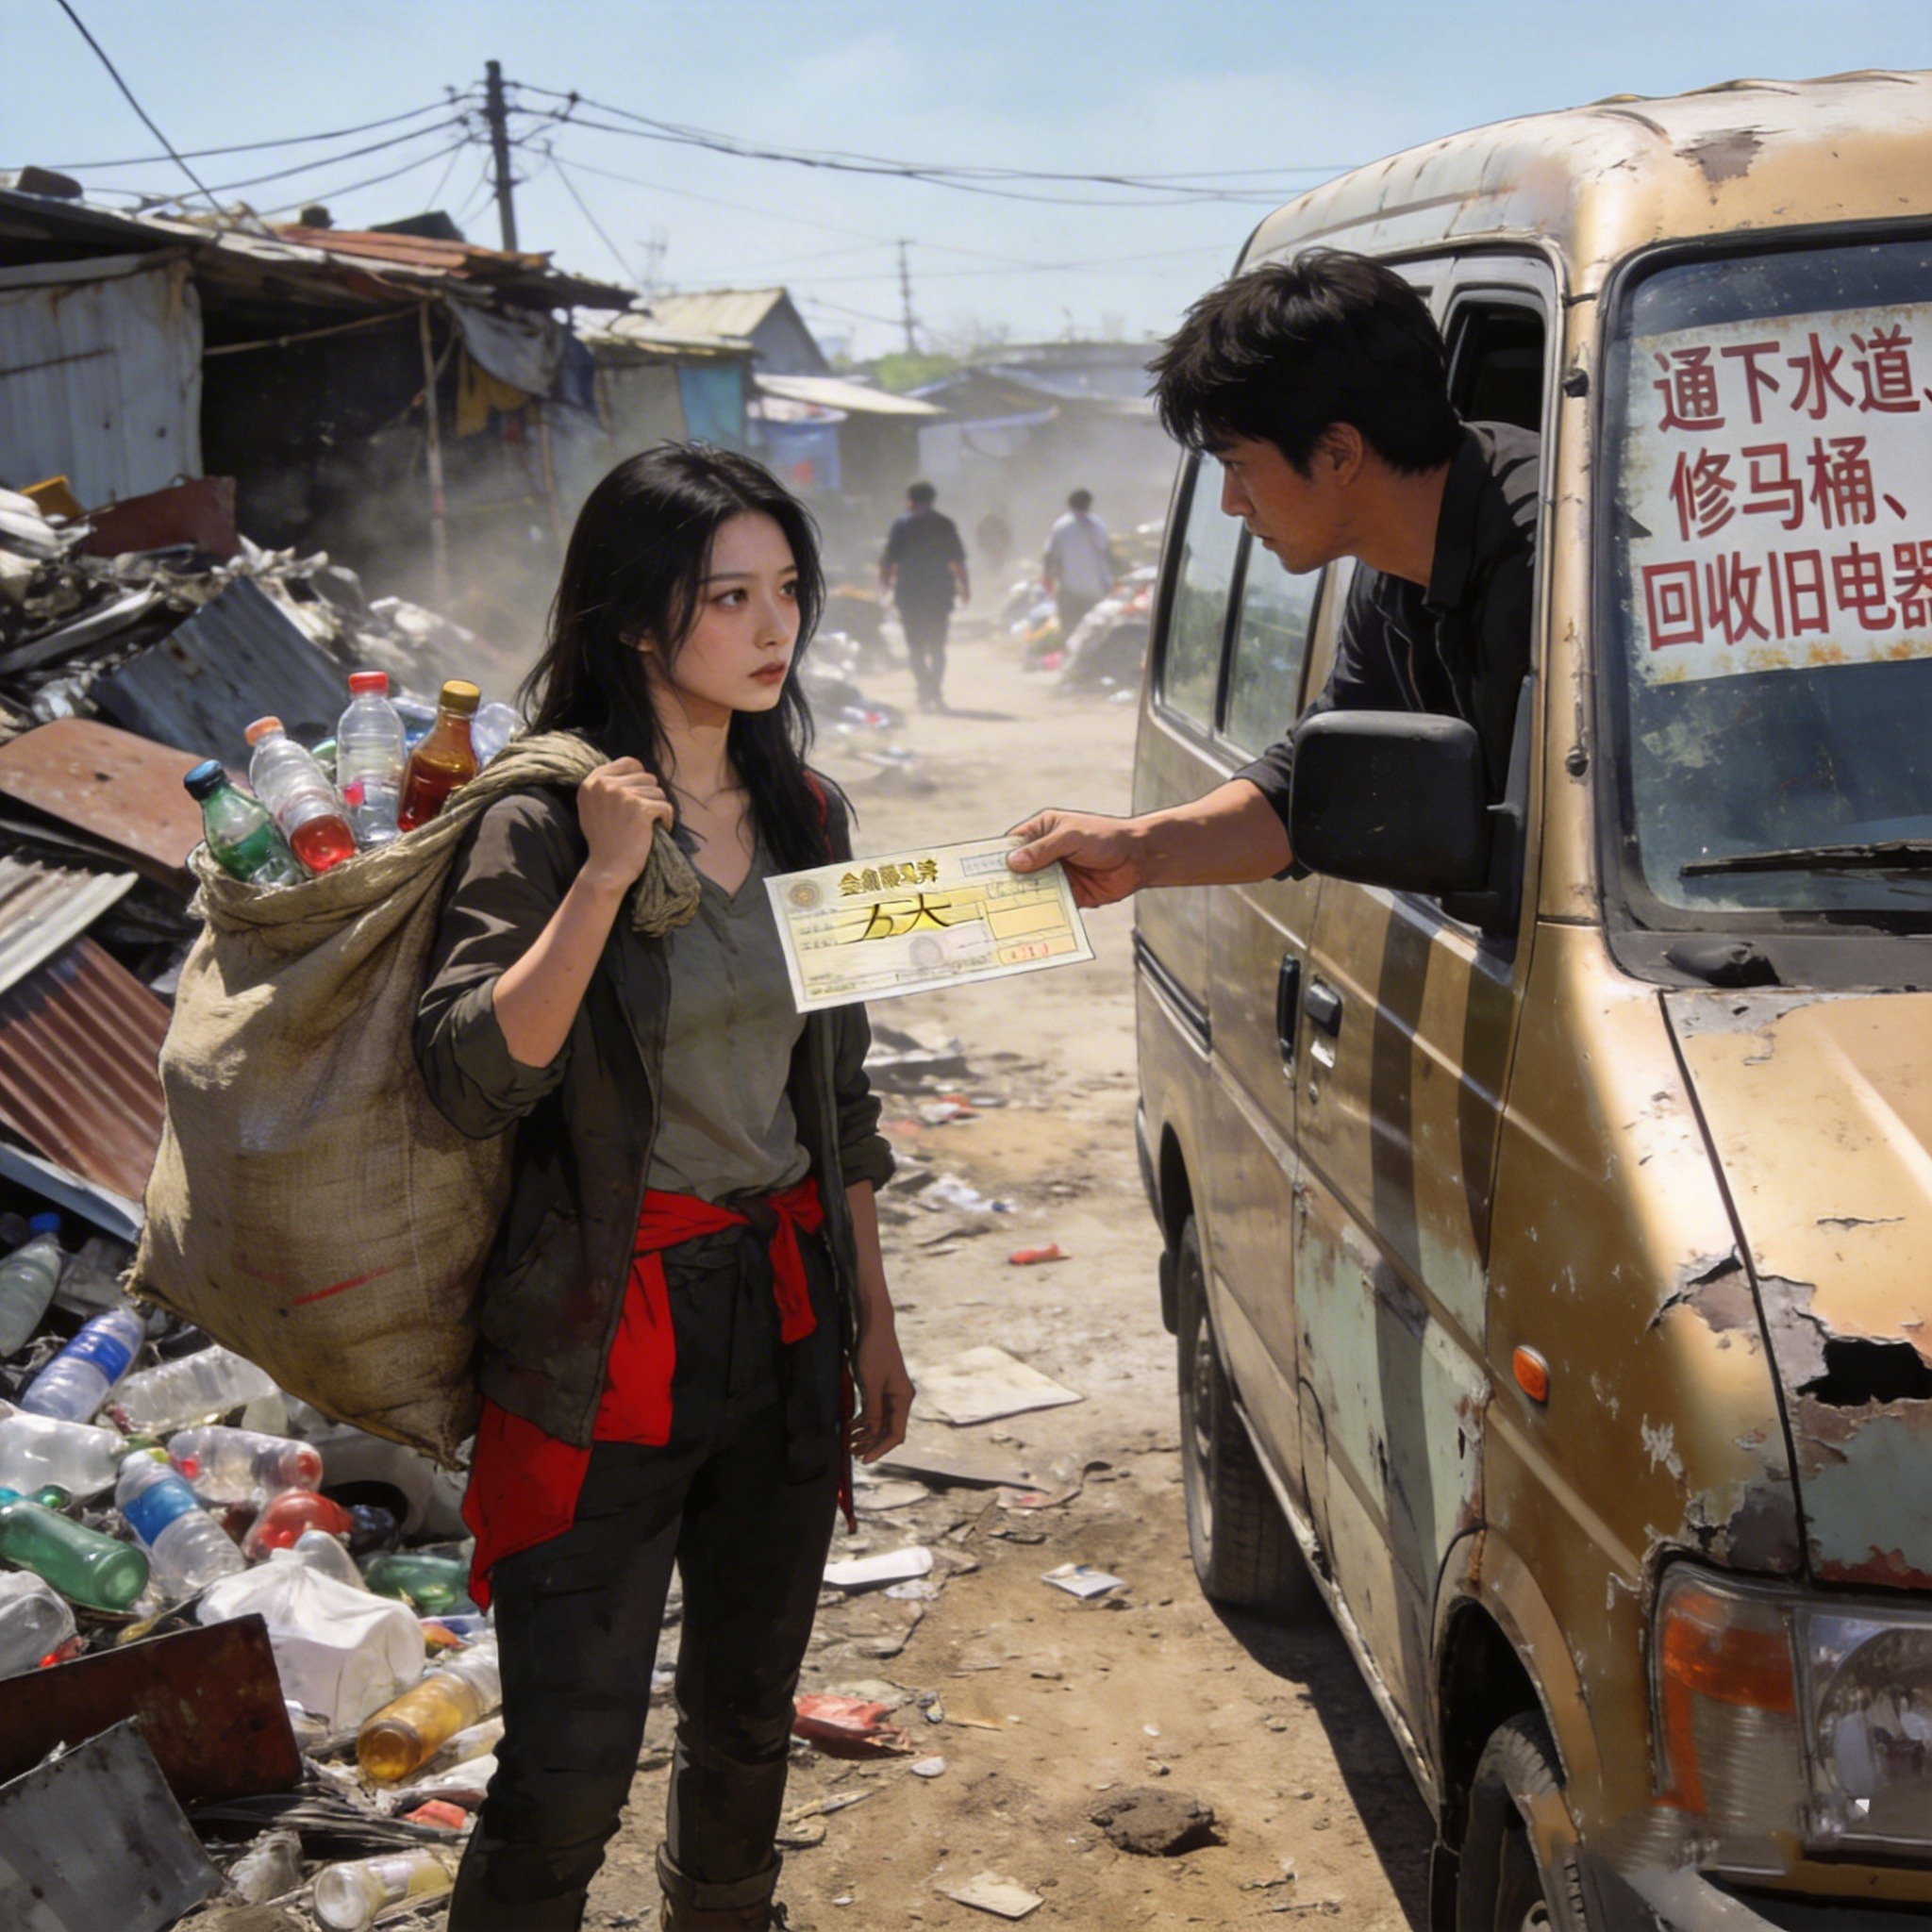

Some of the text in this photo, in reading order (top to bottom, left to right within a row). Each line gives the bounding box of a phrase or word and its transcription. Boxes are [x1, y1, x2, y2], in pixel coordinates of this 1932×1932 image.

[1669, 436, 1907, 541] 修马桶、
[1641, 540, 1932, 651] 回收旧电器
